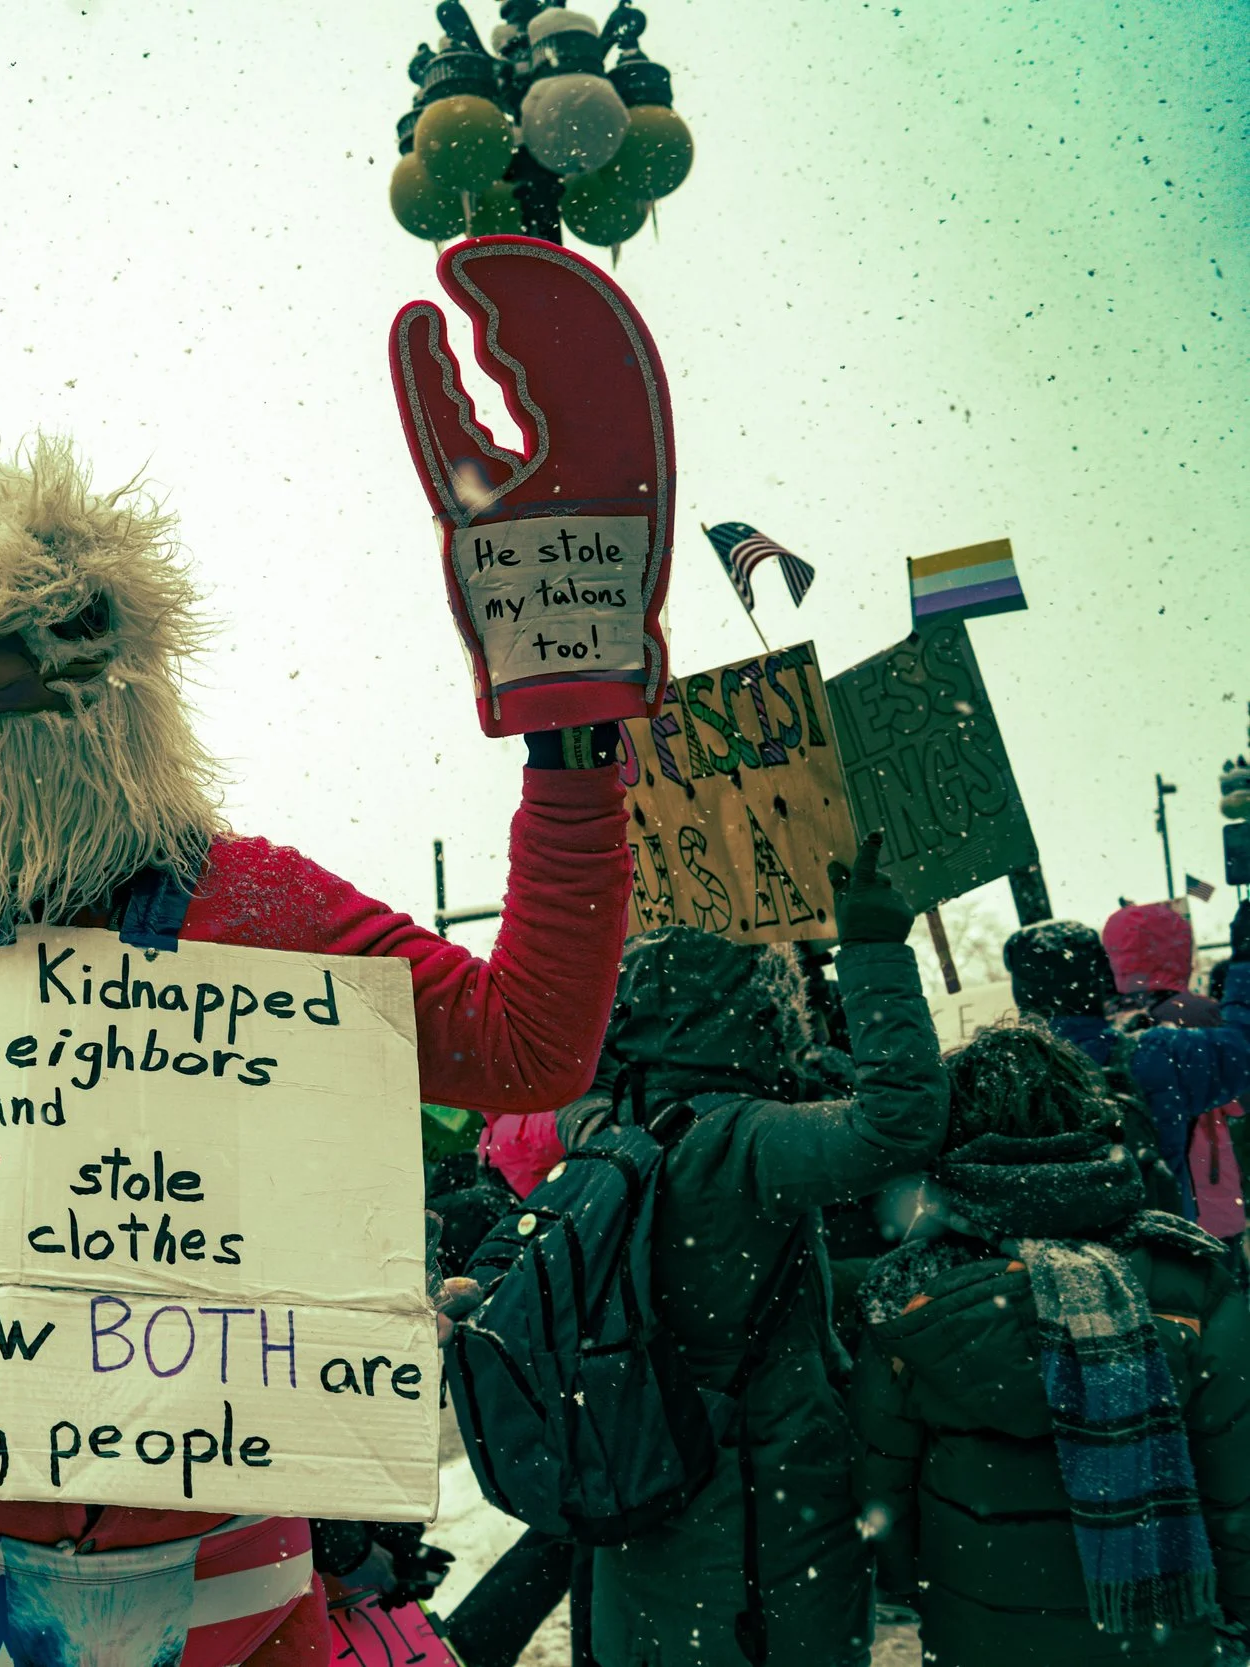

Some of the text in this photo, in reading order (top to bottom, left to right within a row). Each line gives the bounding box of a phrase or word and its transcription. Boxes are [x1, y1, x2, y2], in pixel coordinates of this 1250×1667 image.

[475, 529, 624, 573] He stole
[485, 578, 627, 622] my talons
[532, 624, 602, 661] too!
[38, 942, 341, 1045] Kidnapped
[70, 1148, 205, 1202] stole
[28, 1208, 244, 1266] clothes
[91, 1295, 297, 1389] BOTH
[319, 1356, 424, 1401] are
[50, 1400, 273, 1499] people
